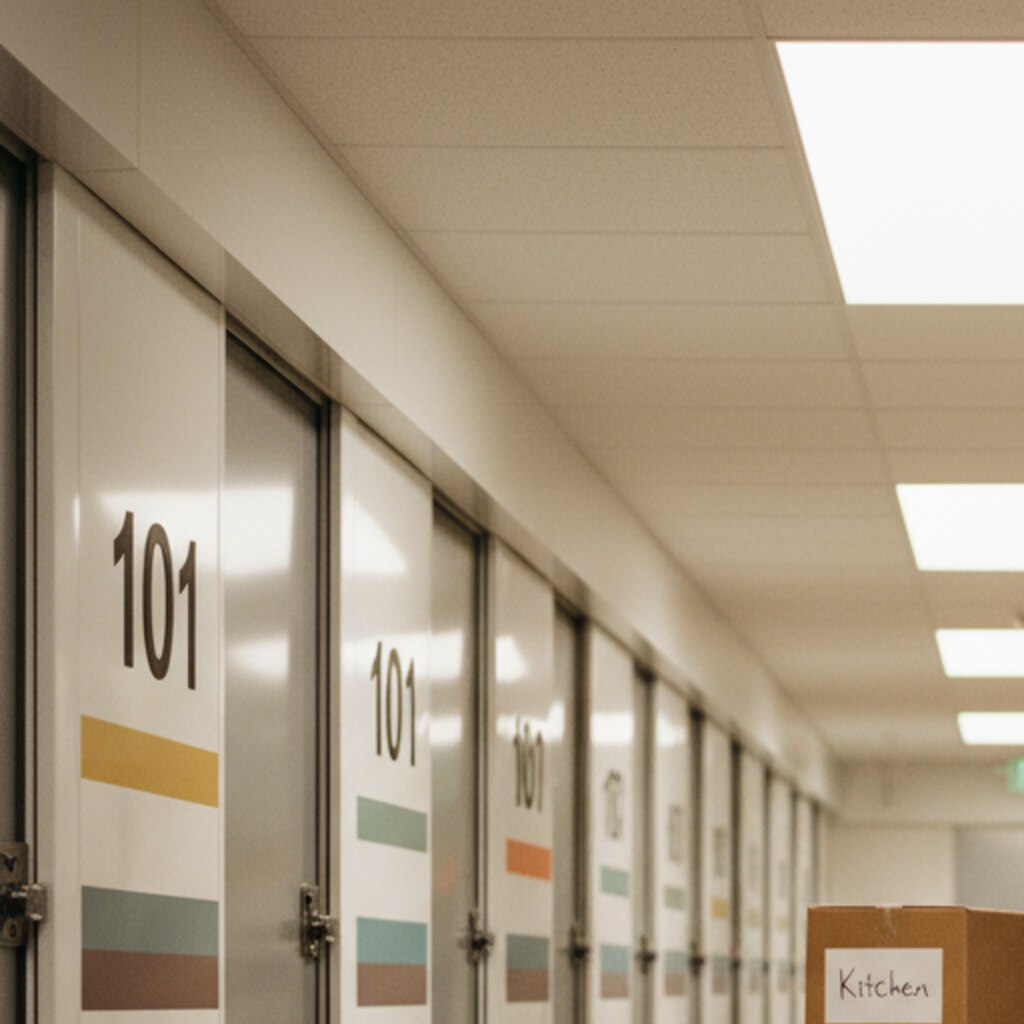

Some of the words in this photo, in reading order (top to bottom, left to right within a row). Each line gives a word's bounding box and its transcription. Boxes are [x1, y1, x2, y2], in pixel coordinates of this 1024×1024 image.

[113, 510, 196, 691] 101
[370, 641, 416, 767] 101
[839, 967, 929, 1000] Kitchen
